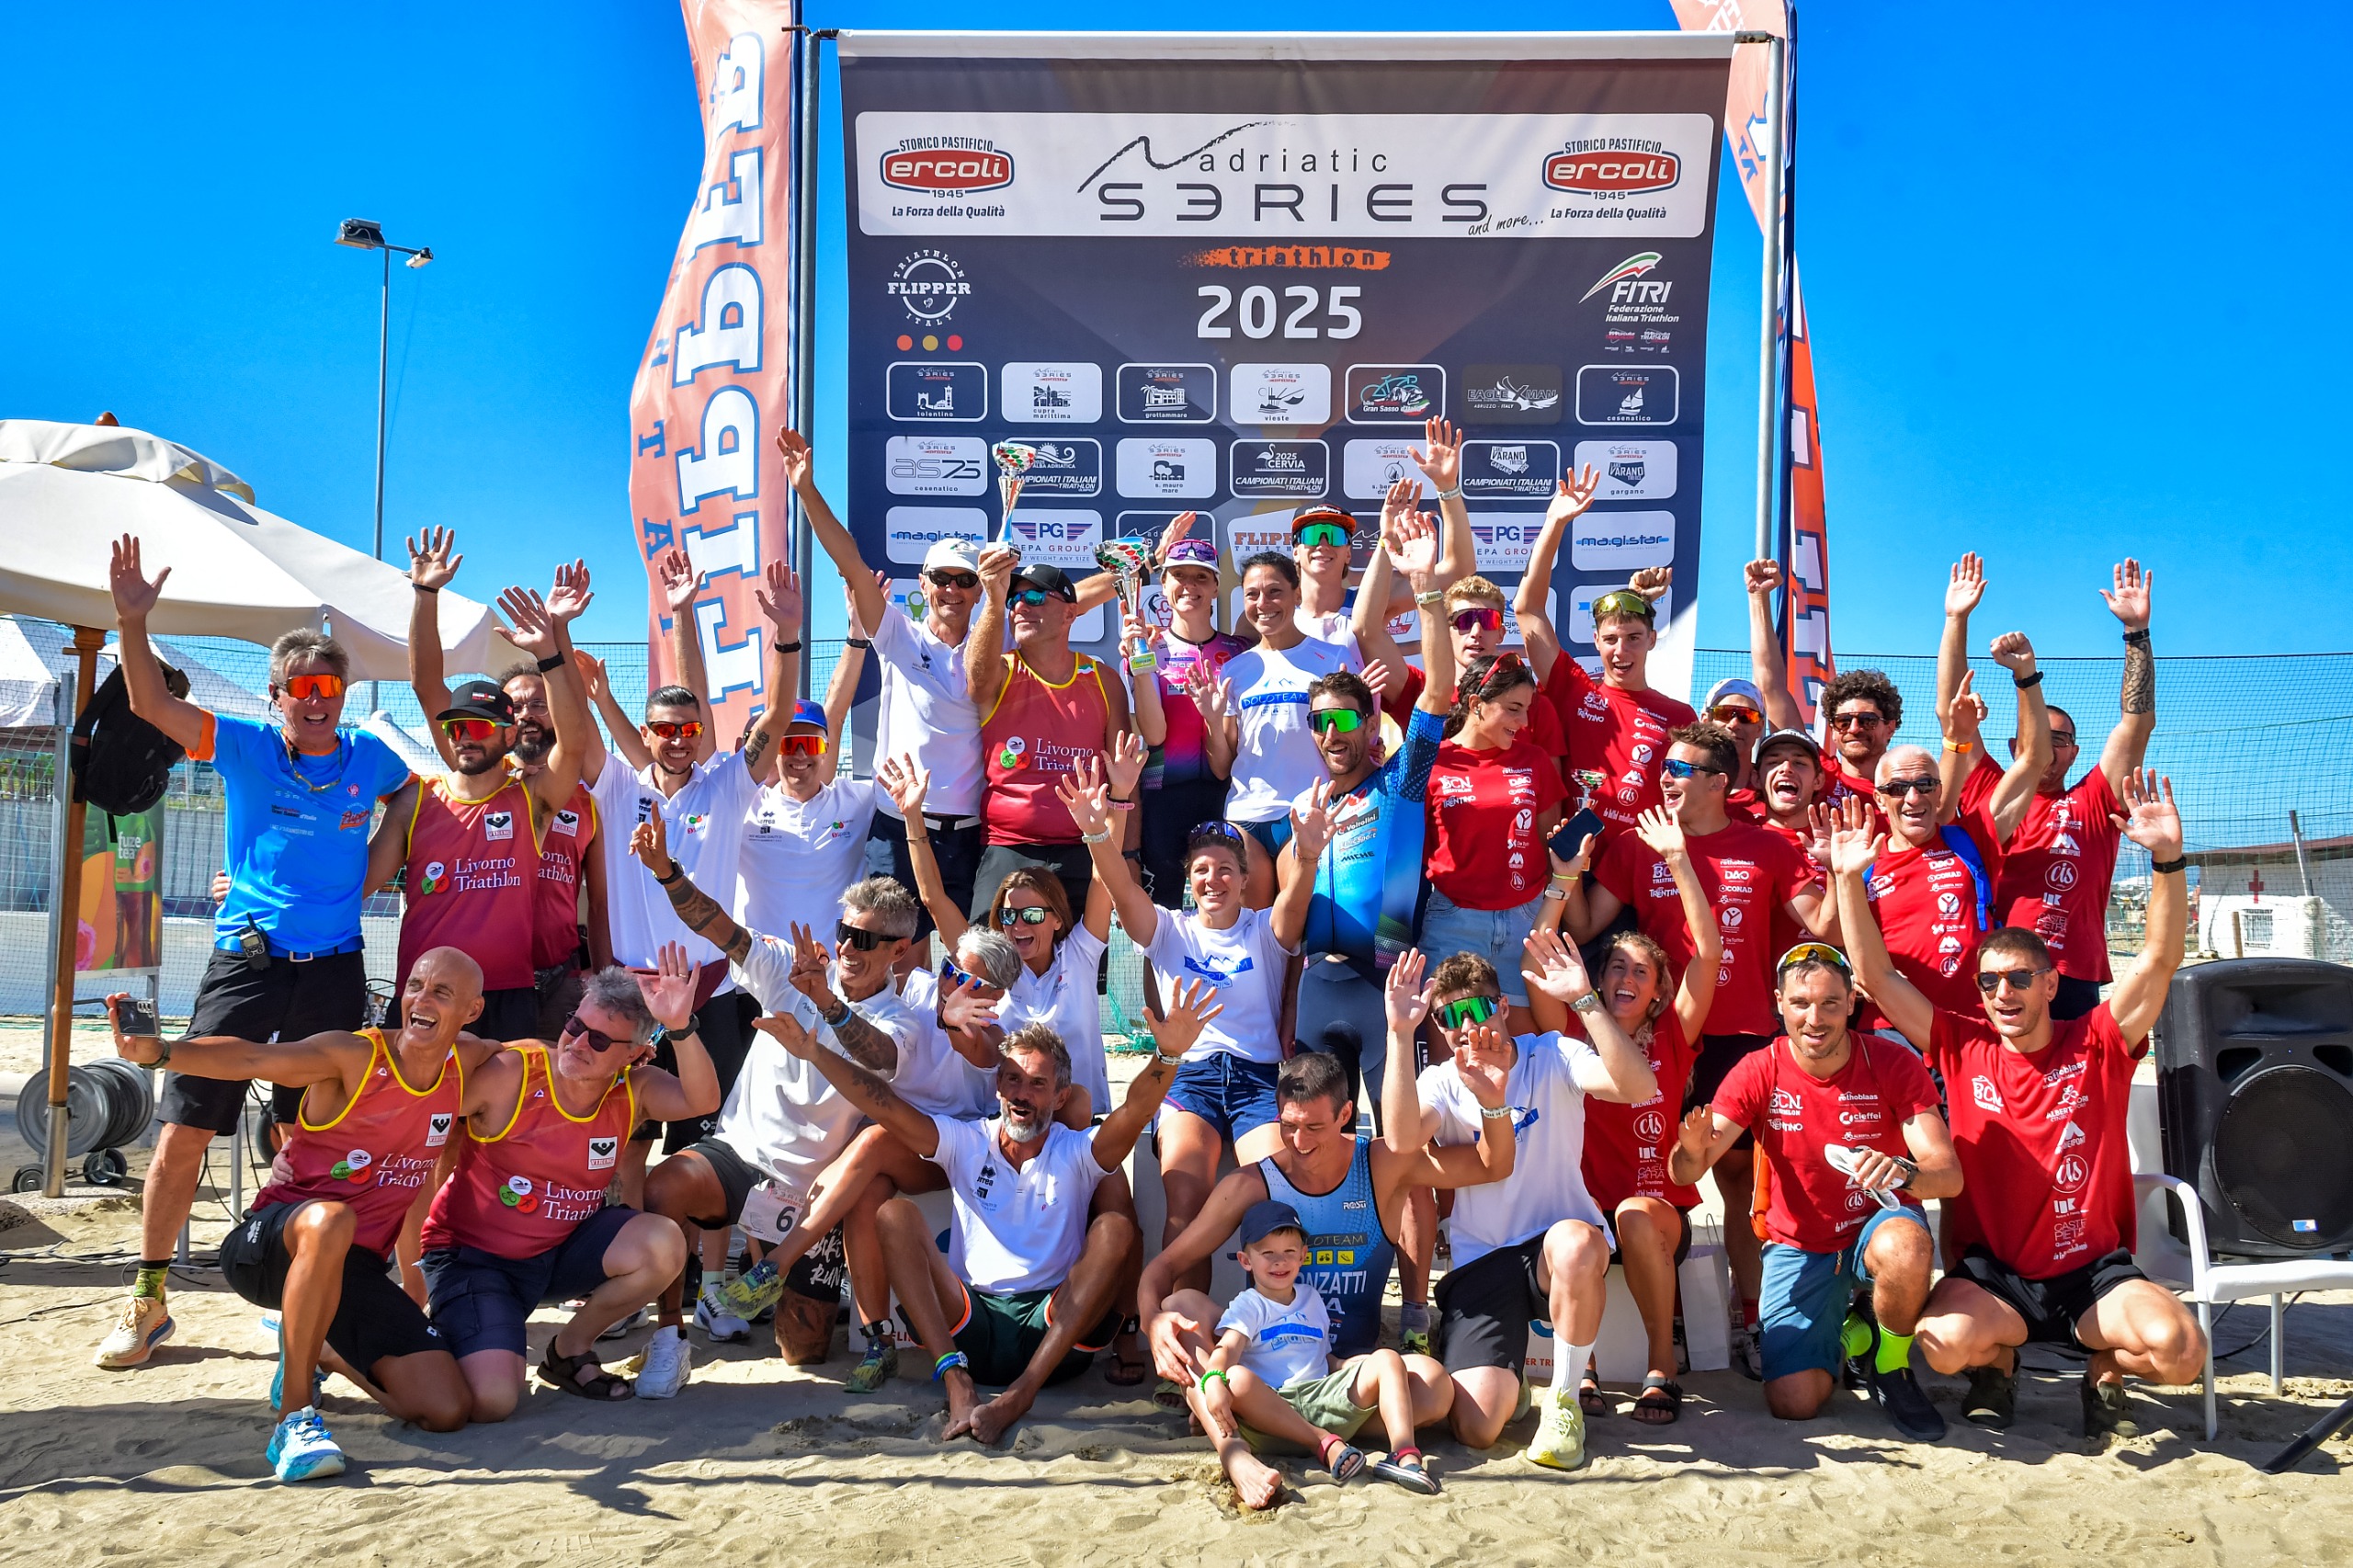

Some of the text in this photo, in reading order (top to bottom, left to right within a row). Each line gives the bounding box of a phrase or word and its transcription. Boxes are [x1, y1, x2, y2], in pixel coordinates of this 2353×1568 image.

[899, 136, 994, 153] STORICO PASTIFICIO
[1564, 138, 1662, 154] STORICO PASTIFICIO
[890, 156, 1004, 178] ercoli
[1199, 147, 1389, 173] adriatic
[1552, 158, 1668, 181] ercoli
[931, 189, 964, 199] 1945
[1593, 191, 1626, 201] 1945
[892, 203, 1006, 219] La Forza della Qualità
[1550, 206, 1667, 222] La Forza della Qualità
[1467, 214, 1545, 237] and more...
[892, 248, 965, 278] TRIATHLON
[1229, 245, 1376, 267] triathlon
[887, 281, 972, 295] FLIPPER
[1609, 280, 1674, 304] FITRI
[1196, 283, 1362, 340] 2025
[1608, 304, 1665, 313] Federazione
[904, 312, 953, 327] ITALY
[1605, 314, 1680, 324] Italiana Triathlon
[1492, 451, 1526, 460] VARANO
[1267, 460, 1306, 469] CERVIA
[1609, 466, 1643, 476] VARANO
[1062, 475, 1097, 483] ITALIANI
[1234, 477, 1324, 485] CAMPIONATI ITALIANI
[1463, 478, 1552, 486] CAMPIONATI ITALIANI
[1039, 523, 1064, 538] PG
[1495, 526, 1520, 541] PG
[1233, 531, 1292, 546] FLIPP
[1242, 693, 1310, 707] DOLOTEAM
[1034, 737, 1094, 757] Livorno
[1443, 795, 1477, 808] TRENTINO
[118, 831, 142, 848] fuze
[118, 847, 135, 860] tea
[542, 850, 572, 866] orno
[1341, 850, 1376, 862] MICHE
[454, 856, 517, 874] Livorno
[1724, 869, 1750, 881] DAO
[2051, 862, 2075, 884] cis
[454, 873, 521, 892] Triathlon
[1726, 884, 1753, 893] CONAD
[1838, 1093, 1879, 1102] rothoblaas
[1640, 1113, 1663, 1135] cis
[2055, 1157, 2083, 1185] cis
[776, 1205, 796, 1233] 6
[810, 1262, 844, 1289] RUN
